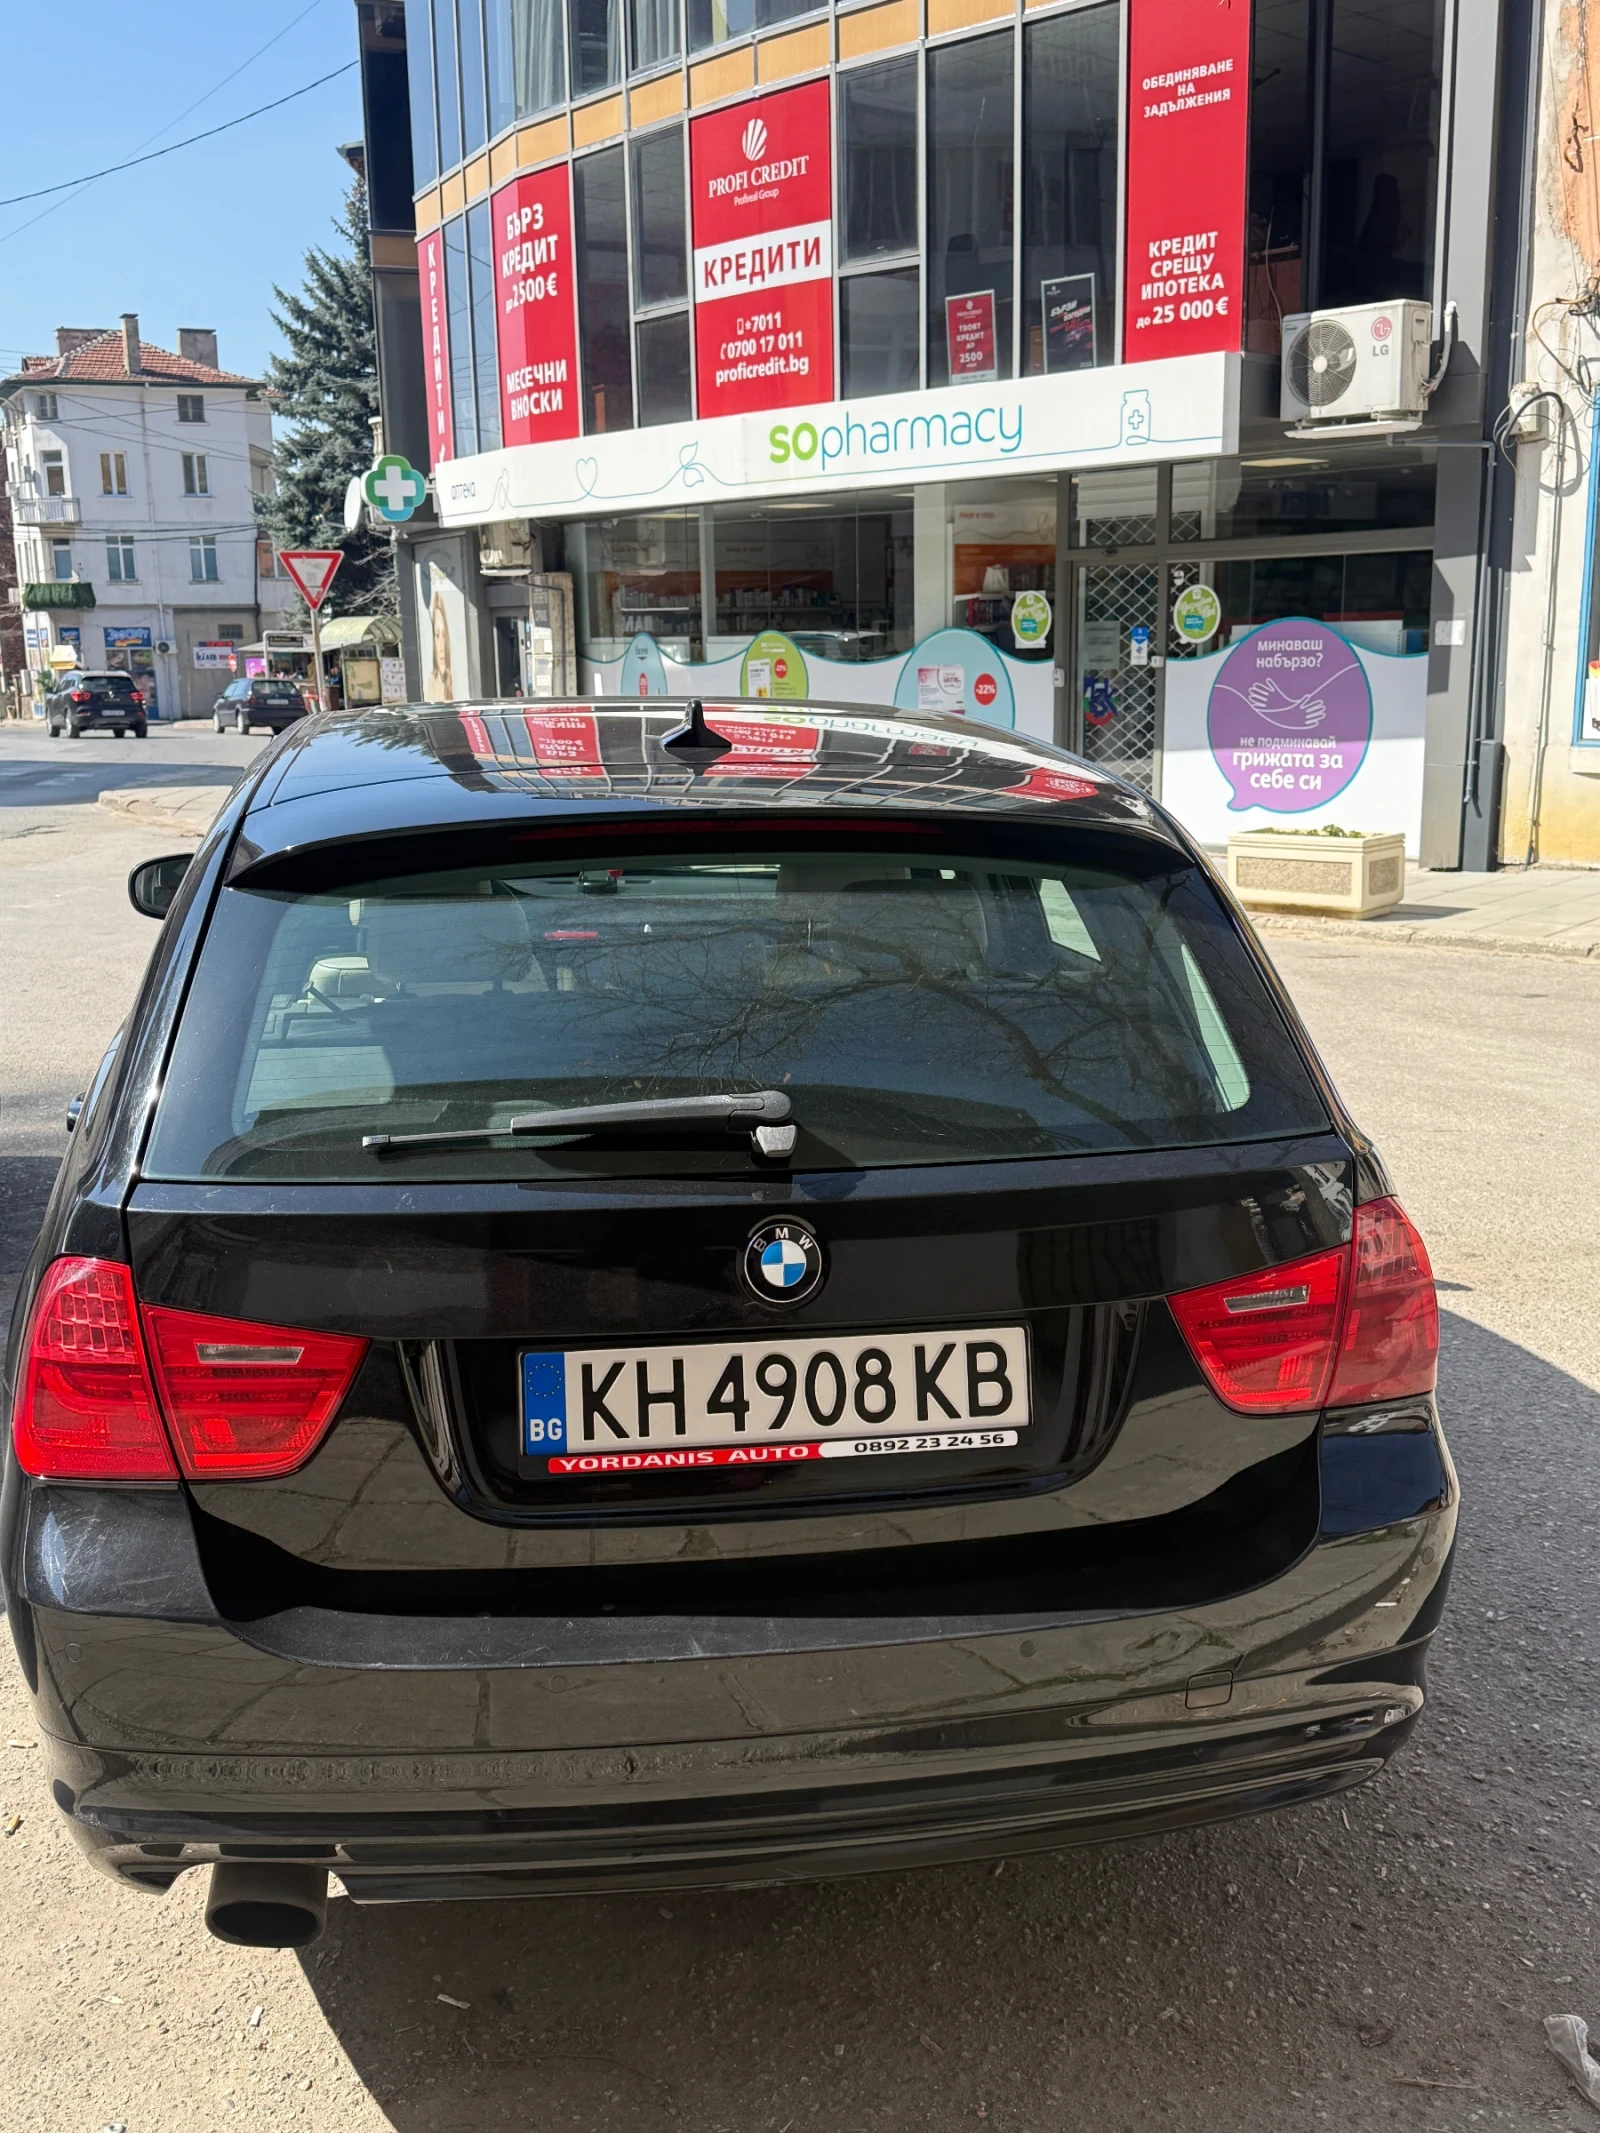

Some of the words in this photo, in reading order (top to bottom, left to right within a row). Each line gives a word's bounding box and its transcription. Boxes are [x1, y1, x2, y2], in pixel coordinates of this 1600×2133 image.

[1142, 59, 1234, 91] ОБЕДИНЯВАНЕ
[1177, 81, 1196, 96] НА
[1143, 88, 1231, 118] ЗАДЪЛЖЕНИЯ
[708, 170, 749, 199] PROFI
[751, 155, 810, 187] CREDIT
[733, 191, 758, 207] Profireal
[758, 187, 779, 202] Group
[506, 202, 544, 241] БЪРЗ
[502, 234, 558, 279] КРЕДИТ
[1148, 231, 1218, 259] КРЕДИТ
[704, 236, 822, 289] КРЕДИТИ
[1150, 252, 1215, 278] СРЕЩУ
[1141, 272, 1225, 300] ИПОТЕКА
[1136, 315, 1151, 329] до
[1152, 304, 1175, 325] 25
[427, 241, 446, 435] КРЕДИТИ
[727, 338, 757, 360] 0700
[760, 336, 774, 353] 17
[778, 331, 803, 351] 011
[956, 331, 985, 342] КРЕДИТ
[959, 351, 983, 364] 2500
[1372, 344, 1389, 357] LG
[507, 359, 567, 394] МЕСЕЧНИ
[715, 354, 809, 388] proficredit.bg
[511, 388, 563, 421] ВНОСКИ
[768, 404, 1023, 471] sopharmacy
[1257, 639, 1323, 652] минаваш
[1256, 653, 1324, 671] набързо?
[975, 684, 996, 695] -22%
[1240, 737, 1255, 747] не
[1257, 735, 1337, 750] подминавай
[1232, 751, 1315, 771] грижата
[1319, 753, 1343, 769] за
[1250, 768, 1295, 790] себе
[1299, 774, 1322, 791] си
[752, 1226, 814, 1253] BMW
[580, 1356, 688, 1442] KH
[706, 1346, 898, 1434] 4908
[913, 1340, 1014, 1423] KB
[529, 1417, 562, 1442] BG
[854, 1439, 911, 1454] 0892
[916, 1437, 942, 1450] 23
[947, 1434, 974, 1448] 24
[979, 1432, 1006, 1446] 56
[559, 1450, 715, 1472] YORDANIS
[727, 1445, 809, 1463] AUTO
